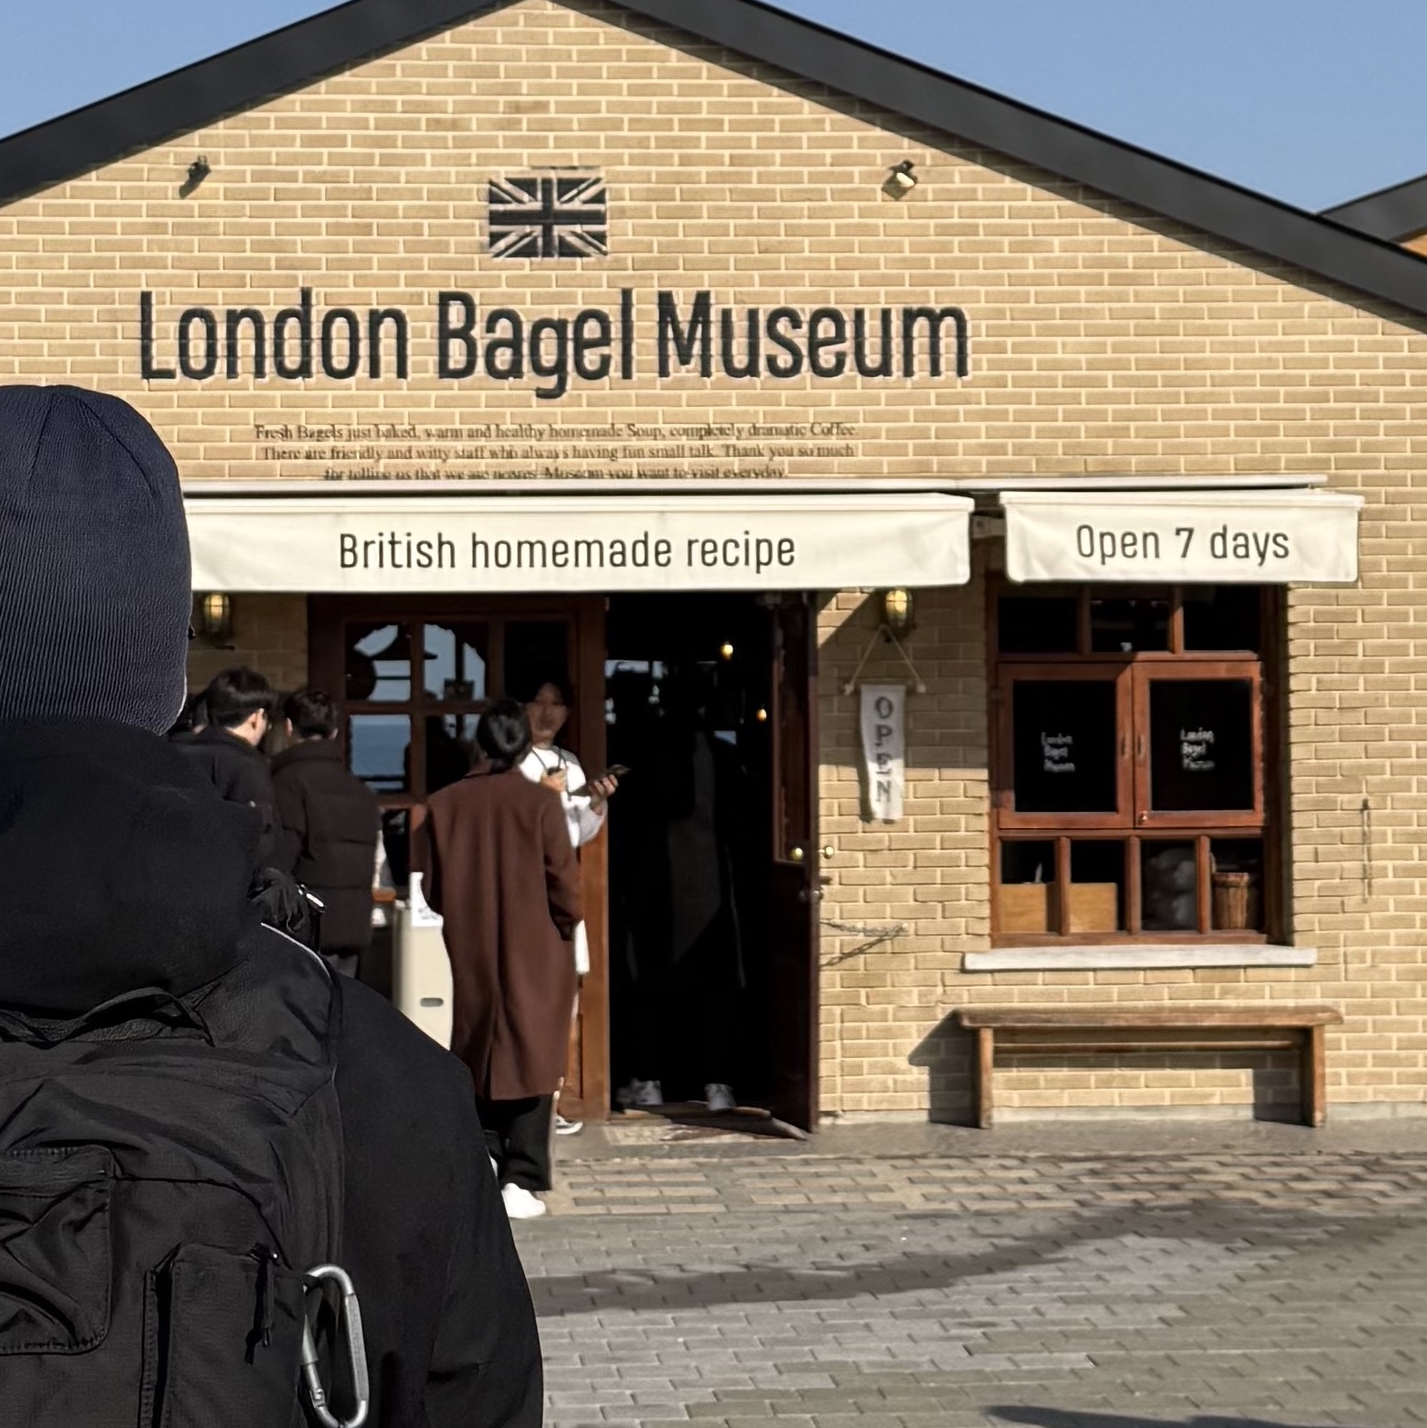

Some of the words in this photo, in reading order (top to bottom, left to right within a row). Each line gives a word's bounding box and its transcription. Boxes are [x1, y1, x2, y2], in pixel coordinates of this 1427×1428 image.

[139, 286, 408, 380] London
[437, 286, 634, 399] Bagel
[657, 289, 969, 379] Museum
[255, 424, 293, 439] Fresh
[297, 424, 343, 443] Bagels
[346, 424, 372, 443] just
[425, 428, 463, 439] warm
[467, 424, 492, 439] and
[495, 424, 543, 442] healthy
[547, 423, 622, 438] homemade
[670, 423, 742, 440] completely
[747, 423, 805, 437] dramatic
[263, 446, 301, 460] There
[305, 449, 327, 460] are
[330, 446, 381, 462] friendly
[387, 446, 412, 460] and
[416, 446, 450, 463] witty
[454, 446, 484, 460] staff
[488, 446, 518, 459] who
[521, 445, 569, 461] always
[573, 445, 618, 461] having
[622, 445, 645, 458] fun
[648, 444, 685, 458] small
[722, 444, 764, 458] Thank
[768, 447, 793, 462] you
[798, 448, 814, 458] so
[816, 444, 854, 457] much
[340, 531, 456, 569] British
[471, 530, 672, 569] homemade
[687, 529, 796, 574] recipe
[1076, 524, 1160, 566] Open
[1175, 527, 1194, 558] 7
[1210, 524, 1290, 567] days
[874, 696, 894, 803] OPEN
